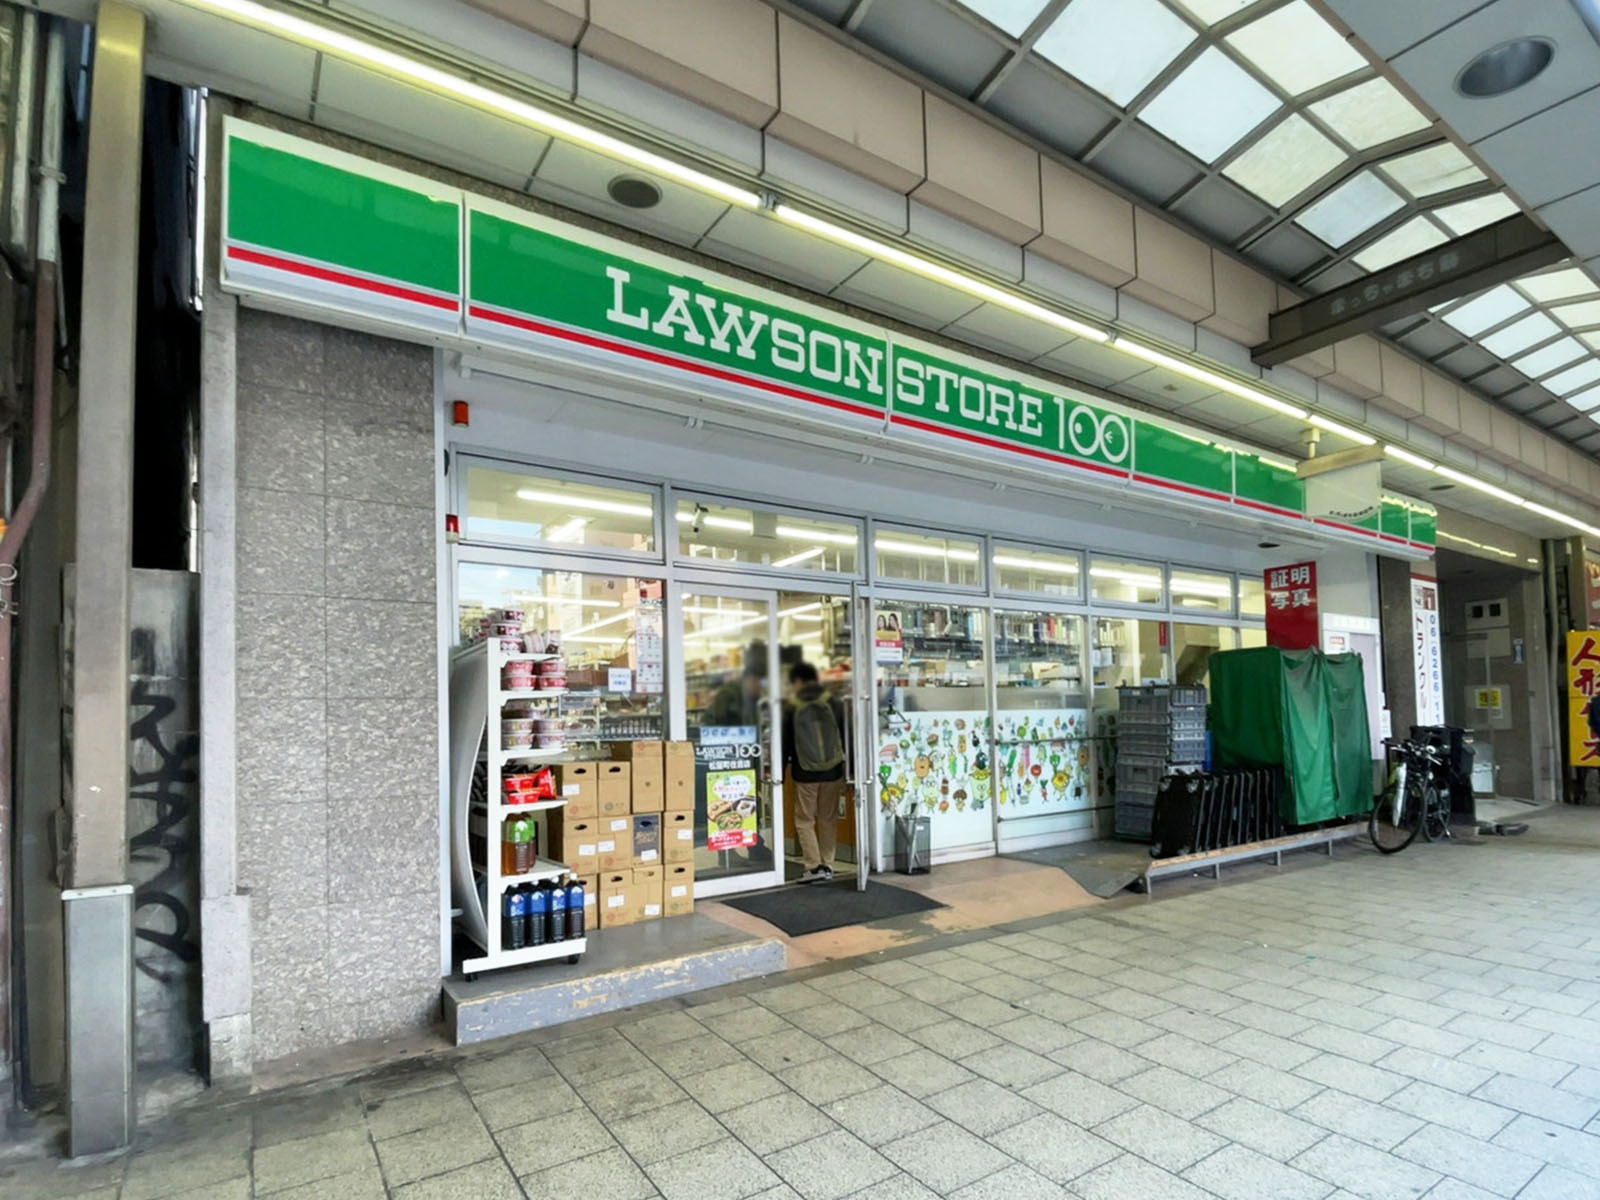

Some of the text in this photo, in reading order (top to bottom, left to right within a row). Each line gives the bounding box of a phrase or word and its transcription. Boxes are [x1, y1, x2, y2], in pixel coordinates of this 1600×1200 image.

[605, 265, 1130, 464] LAWSON STORE 100
[1270, 565, 1311, 589] 証明
[1270, 588, 1312, 610] 写真
